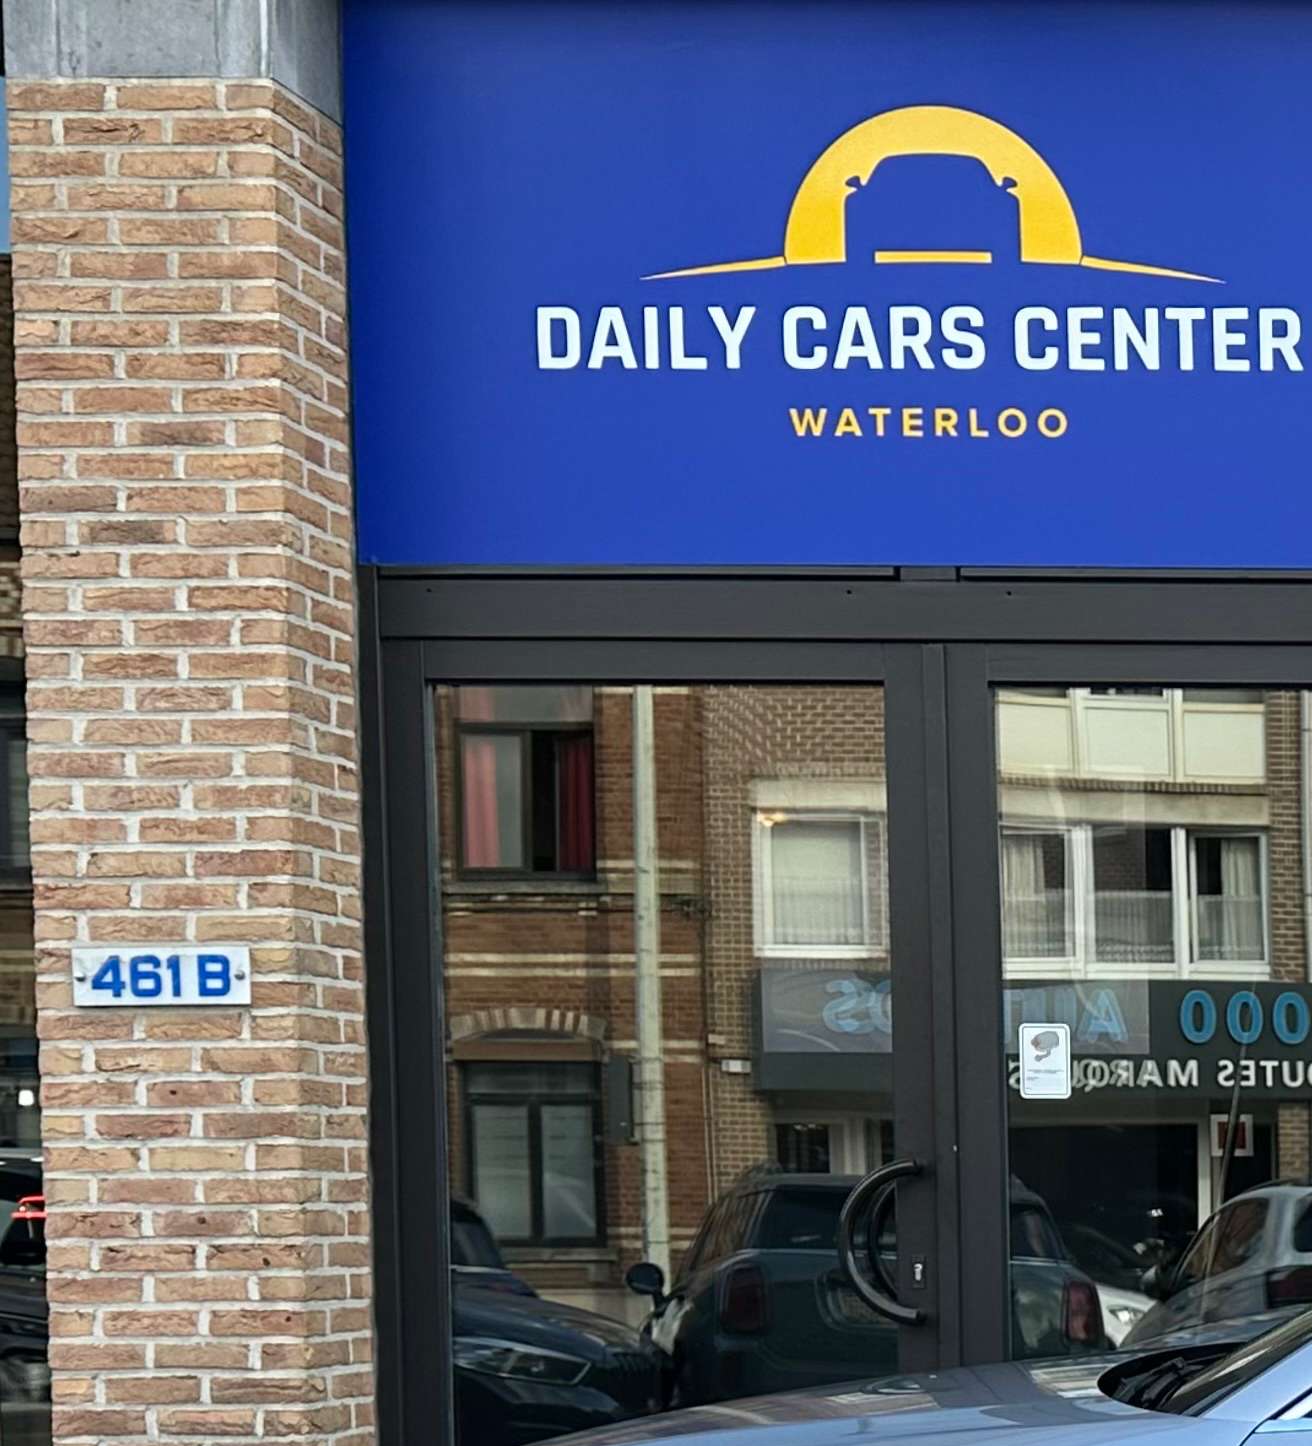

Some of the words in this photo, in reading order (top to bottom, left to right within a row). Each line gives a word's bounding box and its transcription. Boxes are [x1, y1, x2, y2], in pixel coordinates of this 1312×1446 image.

[536, 305, 758, 371] DAILY
[782, 305, 987, 371] CARS
[1013, 305, 1305, 373] CENTER
[788, 406, 1070, 439] WATERLOO
[91, 954, 182, 998] 461
[197, 954, 232, 998] B
